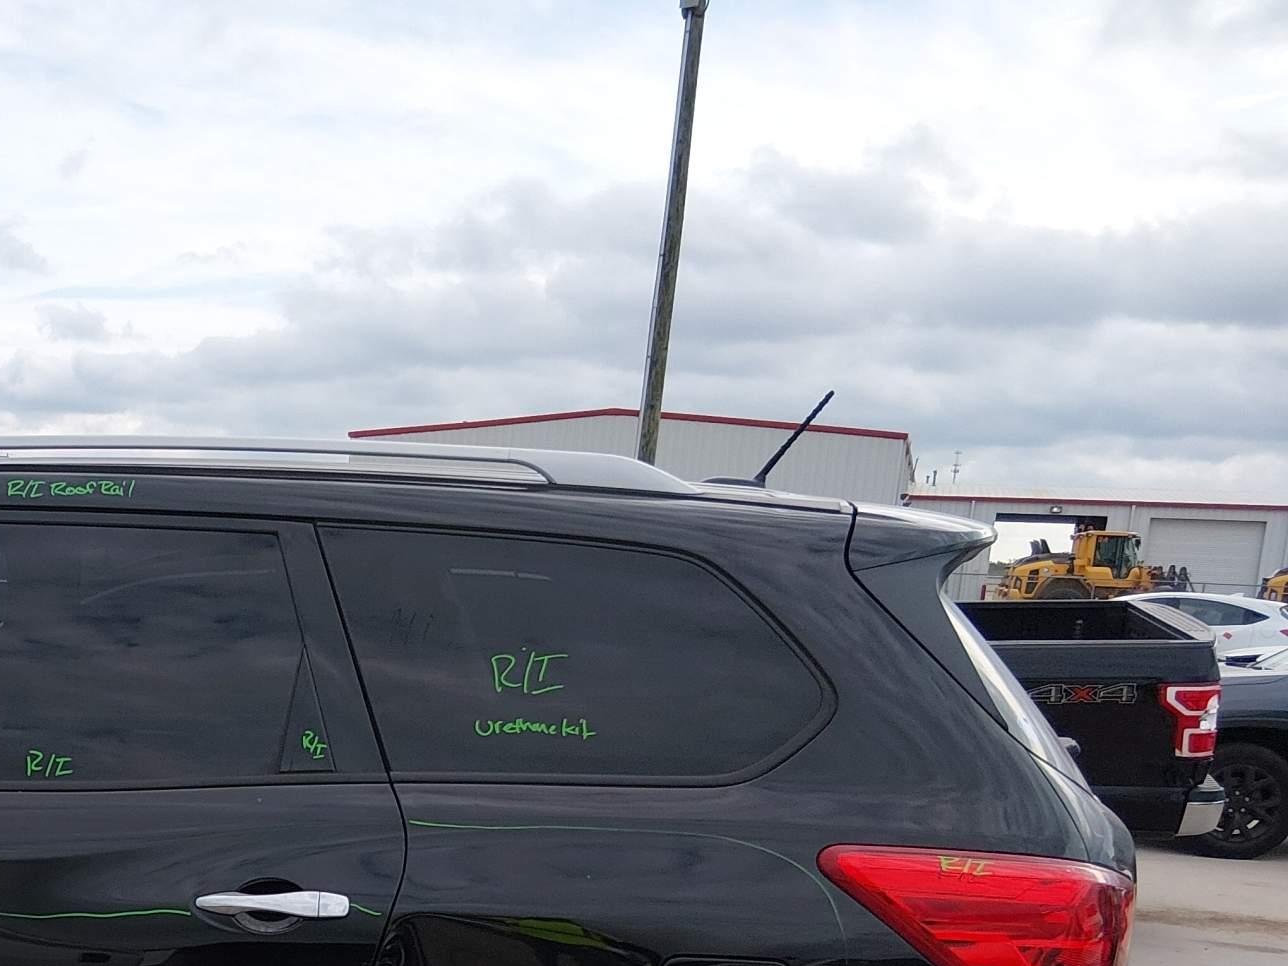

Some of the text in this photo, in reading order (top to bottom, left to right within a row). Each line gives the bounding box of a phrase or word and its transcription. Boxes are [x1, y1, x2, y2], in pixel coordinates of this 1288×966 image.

[7, 480, 135, 498] R/I Roof Rail
[491, 651, 569, 694] R/I
[303, 730, 328, 759] R/I
[25, 750, 73, 776] R/I
